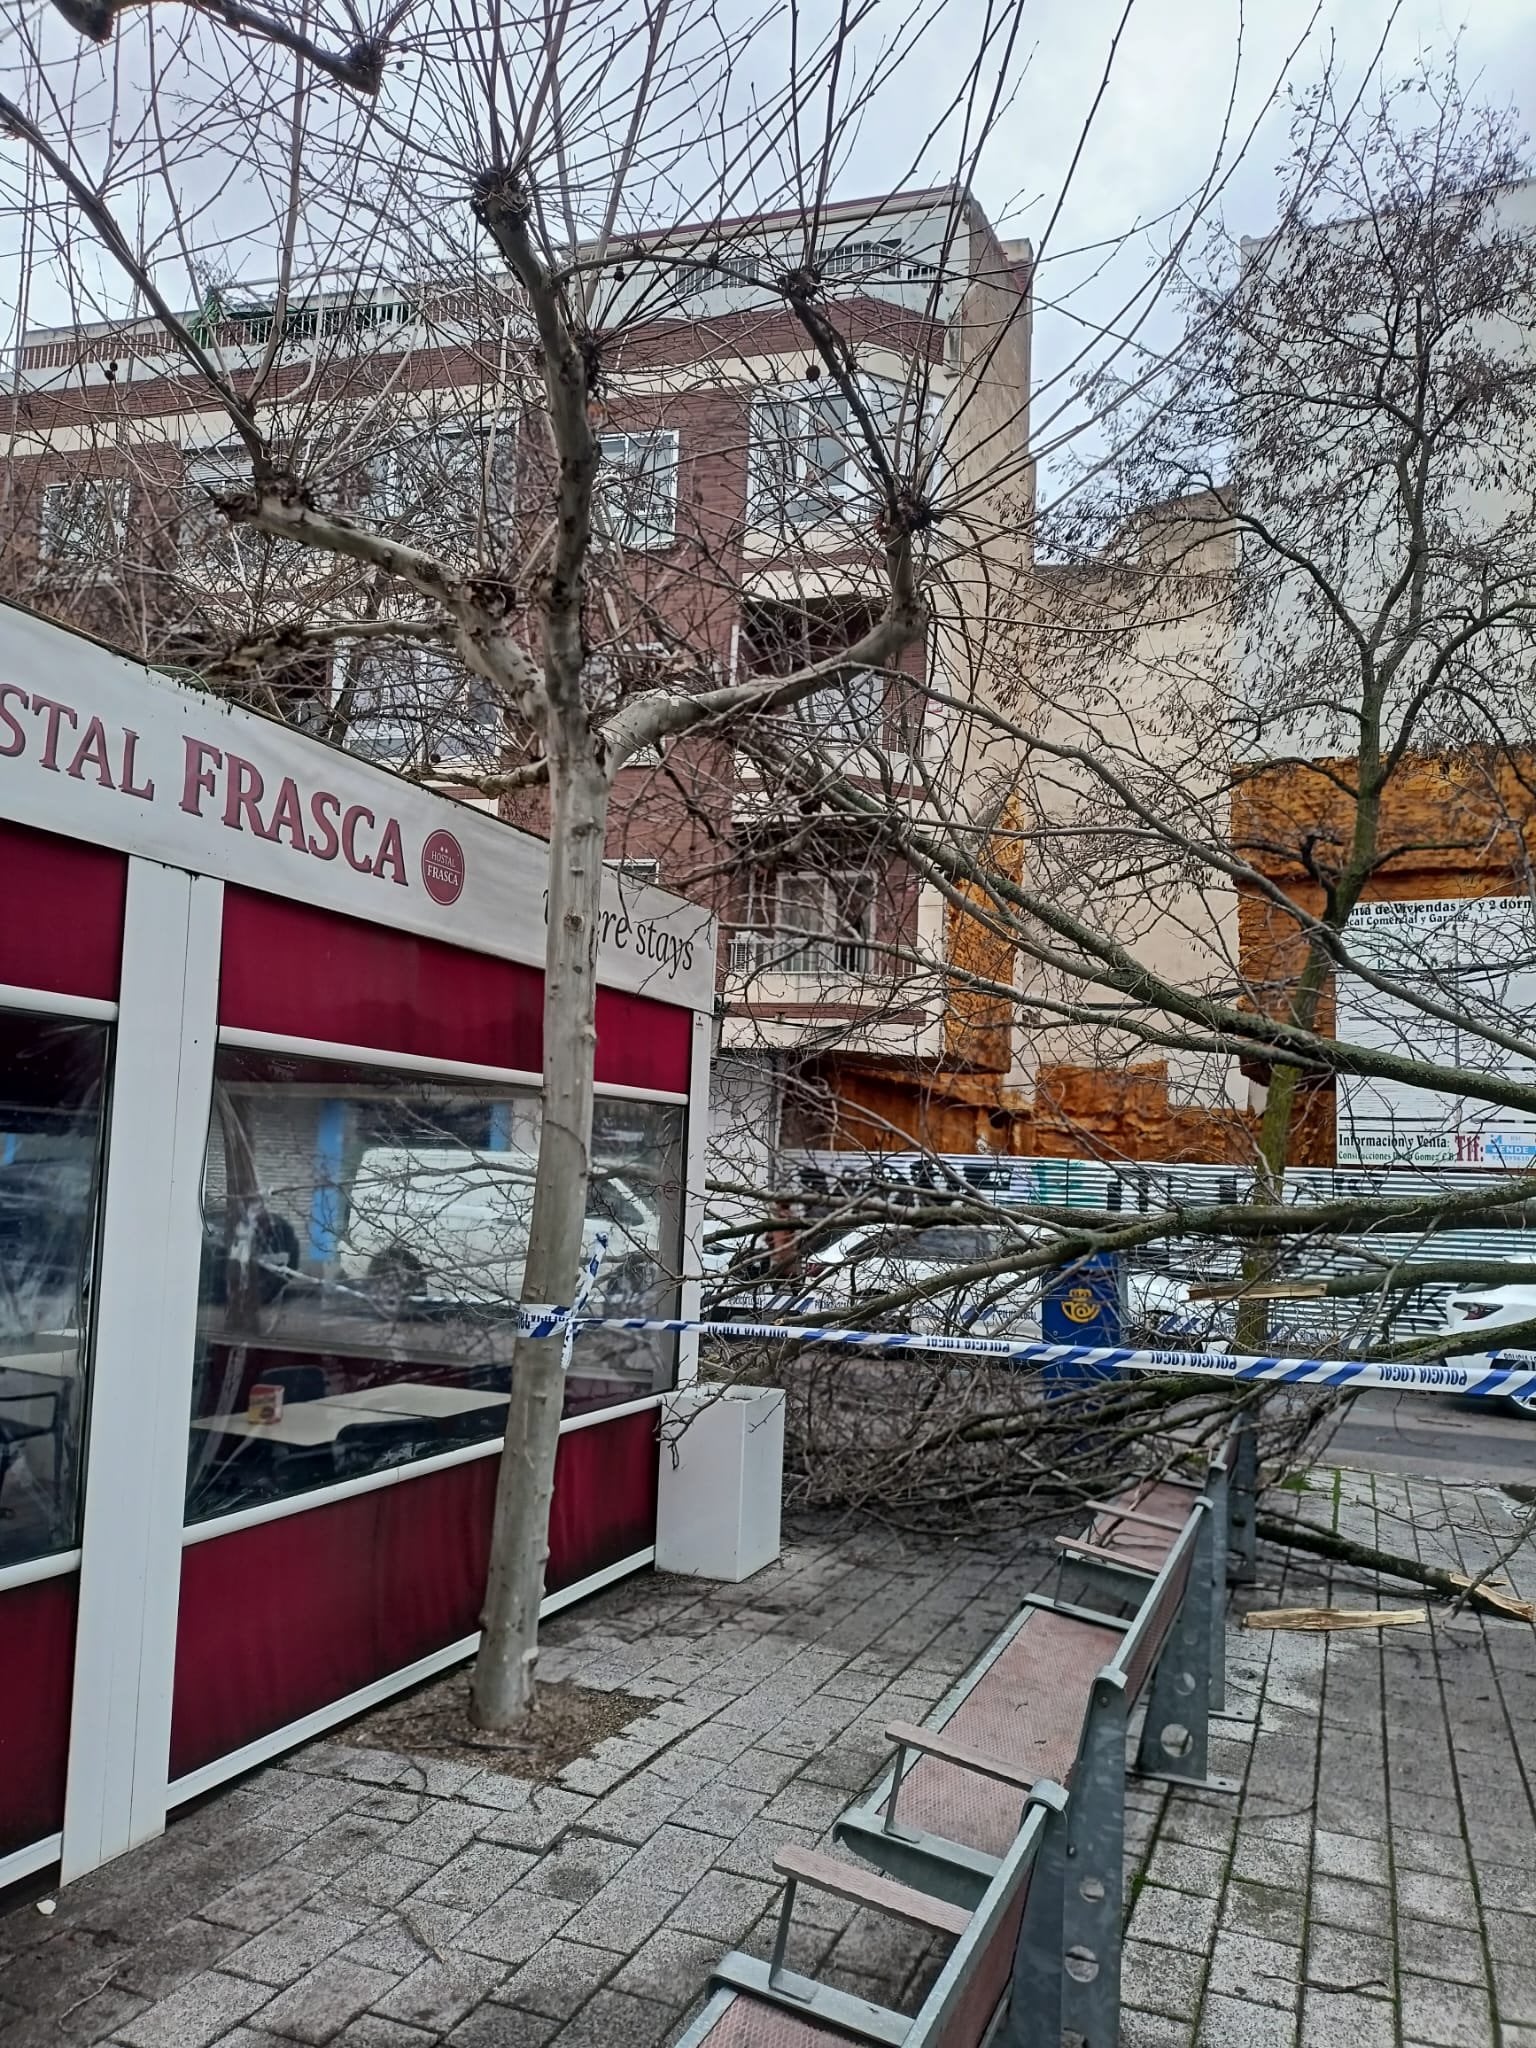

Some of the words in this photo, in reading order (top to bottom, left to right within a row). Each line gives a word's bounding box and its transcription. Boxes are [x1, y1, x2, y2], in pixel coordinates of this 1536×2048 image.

[178, 734, 409, 887] FRASCA
[431, 851, 456, 868] HOSTAL
[427, 864, 459, 886] FRASCA
[1375, 904, 1390, 915] de
[1394, 901, 1456, 914] Viviendas
[1489, 900, 1496, 909] 2
[635, 920, 694, 980] stays
[1151, 1350, 1186, 1366] LOCAL
[1190, 1353, 1237, 1370] POLICIA
[1378, 1364, 1415, 1383] LOCAL
[1418, 1367, 1468, 1386] POLICIA
